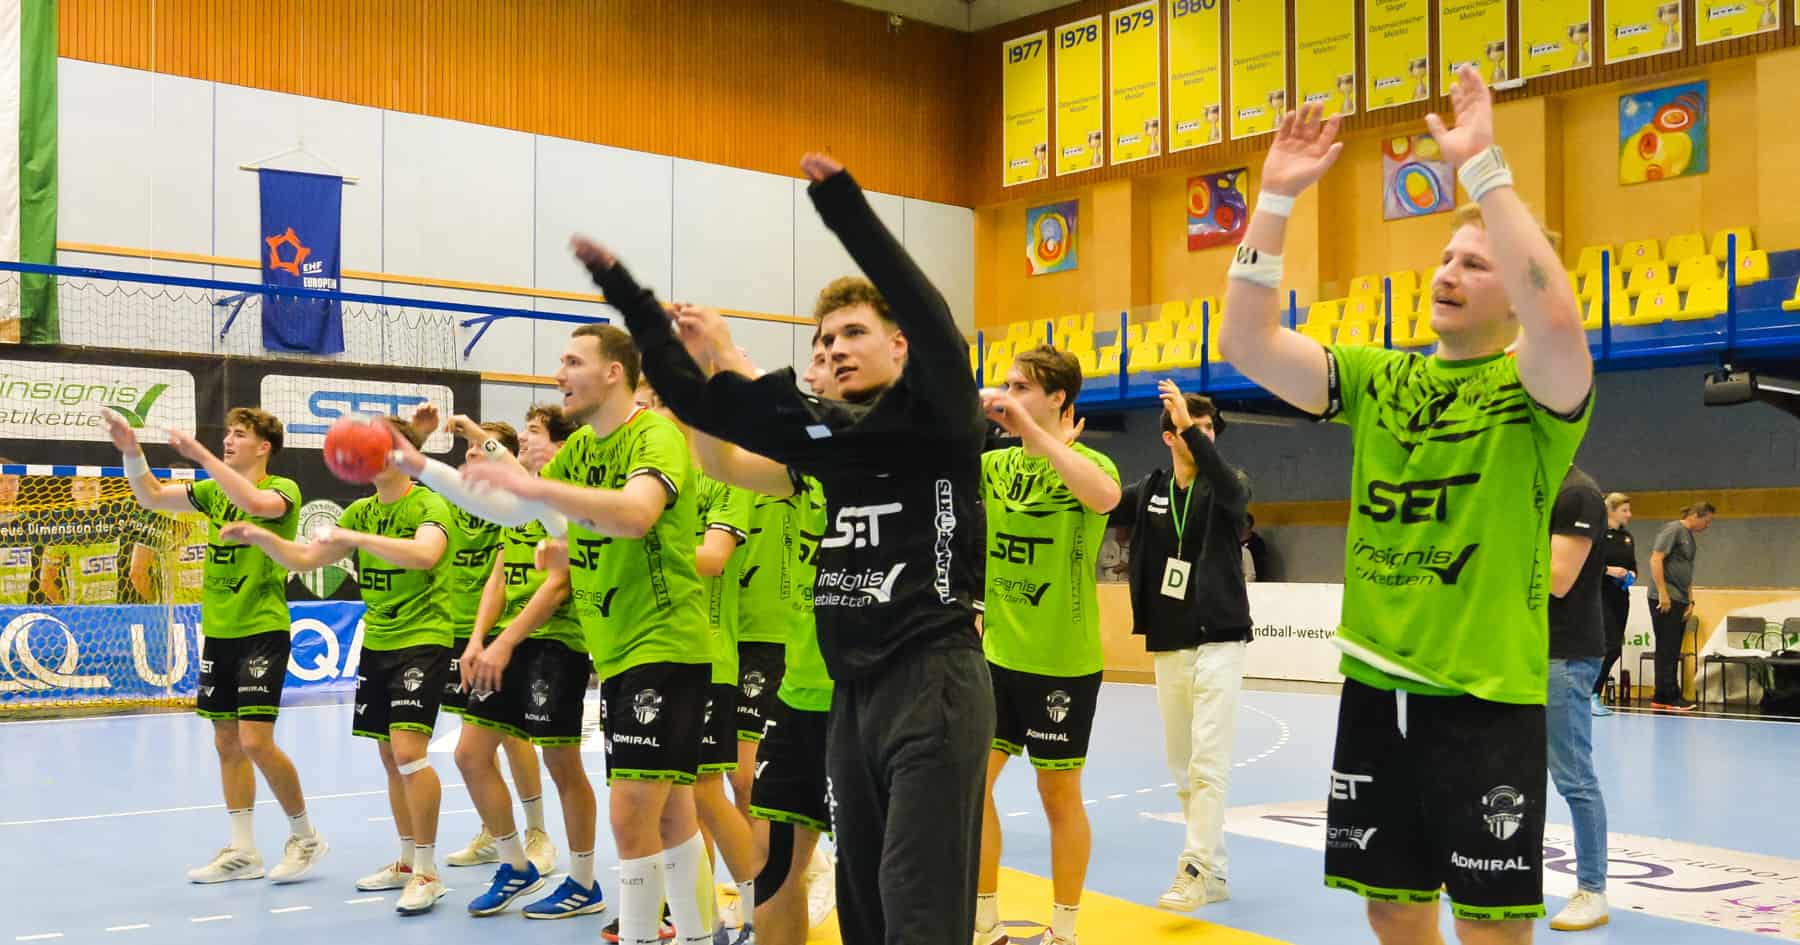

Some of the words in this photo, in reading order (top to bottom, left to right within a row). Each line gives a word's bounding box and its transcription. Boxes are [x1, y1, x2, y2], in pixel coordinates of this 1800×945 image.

[1116, 9, 1154, 35] 1979
[1060, 24, 1097, 49] 1978
[1009, 40, 1042, 64] 1977
[0, 374, 138, 406] insignis
[0, 408, 101, 427] etikette
[1358, 473, 1481, 523] SET
[0, 526, 24, 537] eue
[821, 502, 902, 548] SET
[990, 532, 1054, 565] SET
[818, 568, 884, 591] insignis
[1168, 568, 1184, 588] D
[1622, 631, 1650, 647] .at
[737, 706, 761, 717] IRAL
[1330, 770, 1373, 800] ET
[1329, 827, 1362, 837] gnis
[1451, 851, 1530, 871] ADMIRAL
